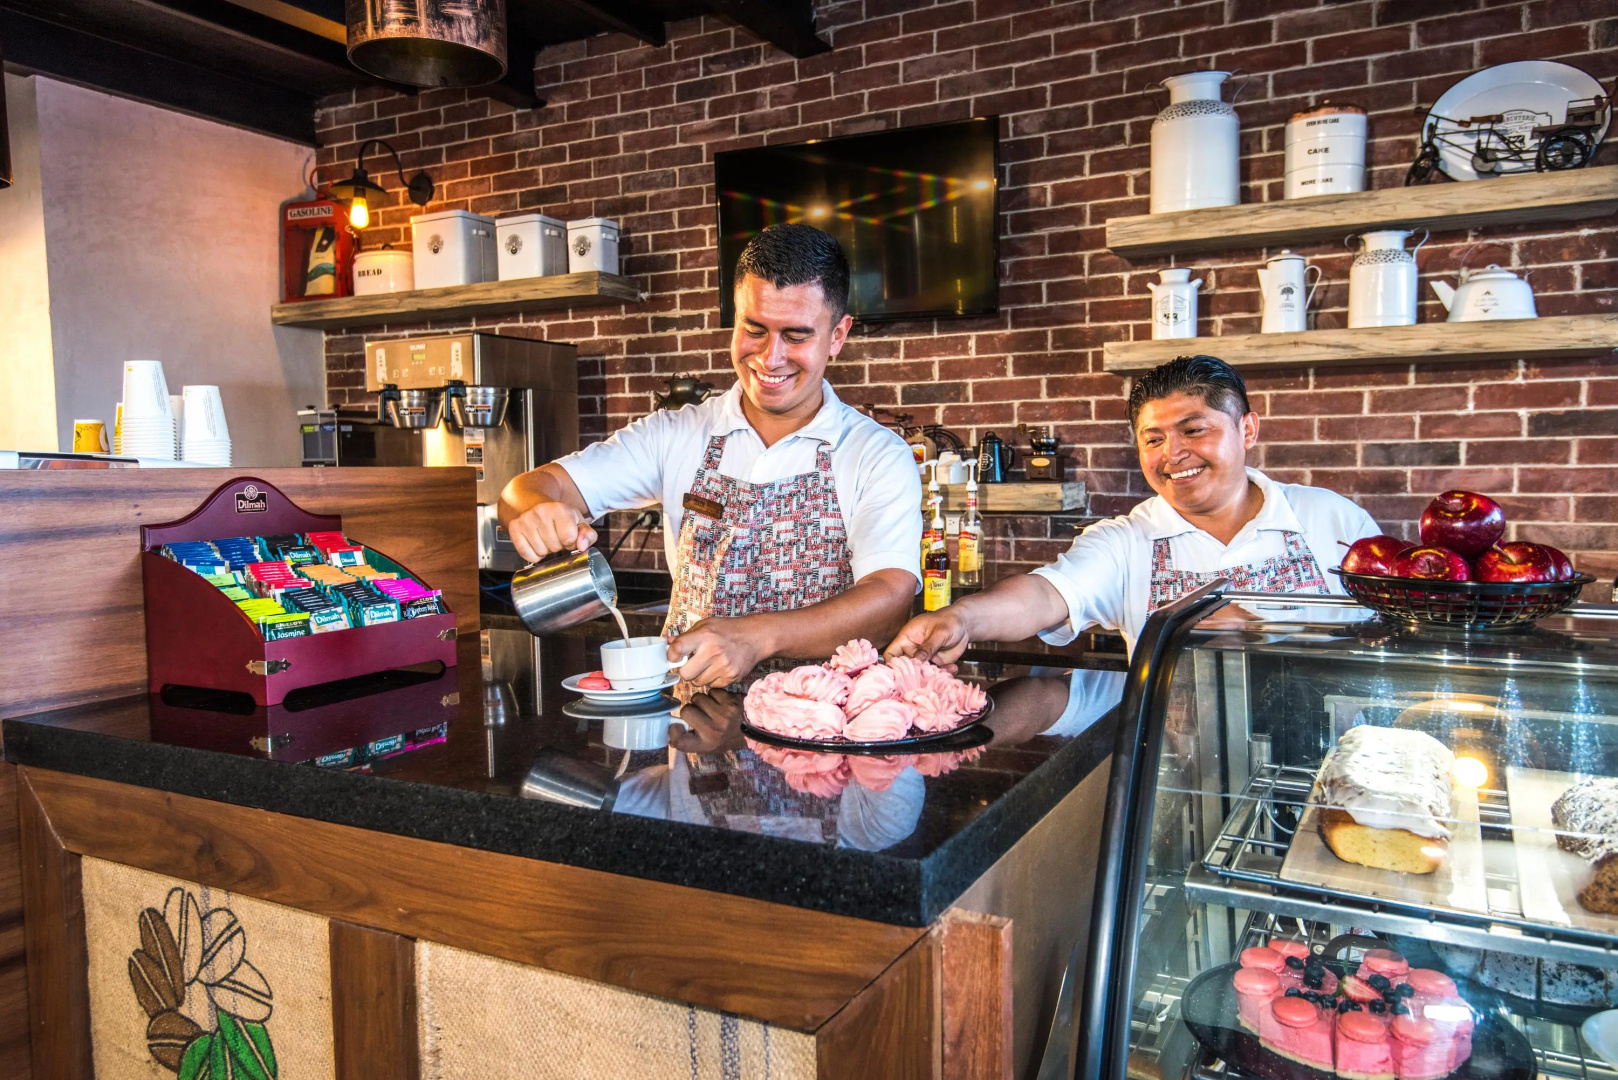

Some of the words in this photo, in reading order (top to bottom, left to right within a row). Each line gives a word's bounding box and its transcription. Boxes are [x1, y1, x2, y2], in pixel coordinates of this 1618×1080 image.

[1307, 147, 1330, 155] CAKE
[289, 206, 334, 218] GASOLINE
[357, 268, 383, 277] BREAD
[237, 499, 265, 509] Dilmah
[289, 550, 311, 559] Dilmah
[315, 612, 341, 624] Dilmah
[370, 608, 392, 619] Dilmah
[277, 629, 306, 639] Jasmine
